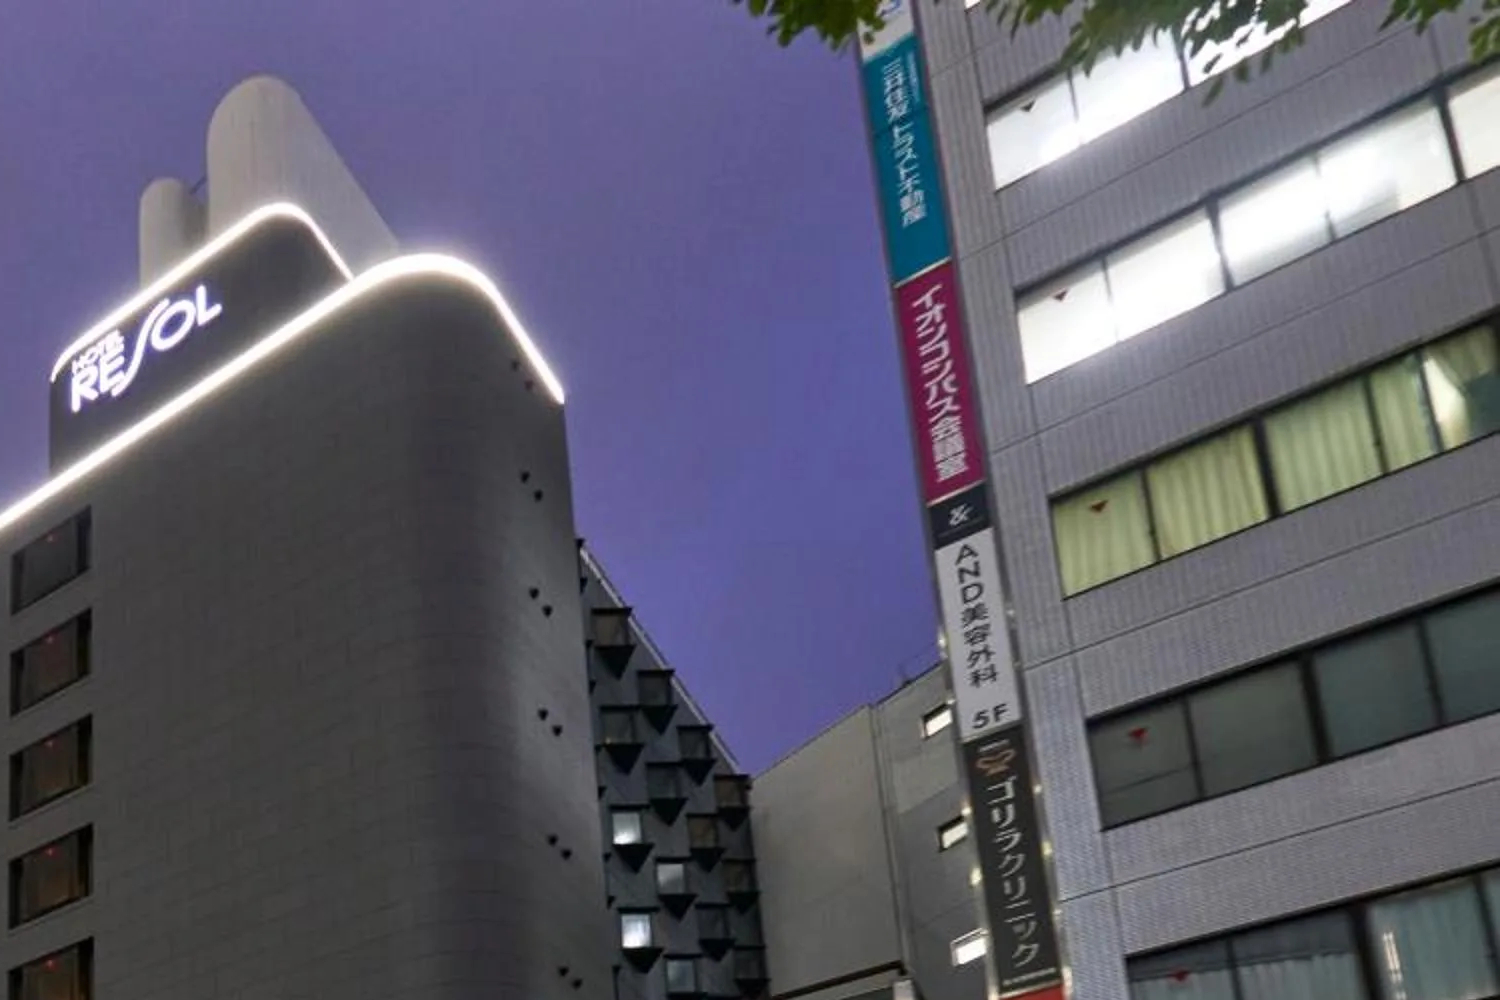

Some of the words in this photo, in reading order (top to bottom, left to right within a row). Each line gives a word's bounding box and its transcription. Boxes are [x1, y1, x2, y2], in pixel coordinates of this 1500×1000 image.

[70, 283, 223, 413] RESOL
[955, 543, 1000, 688] AND美容外科
[971, 703, 1010, 730] 5F
[986, 776, 1041, 968] ゴリラクリニック
